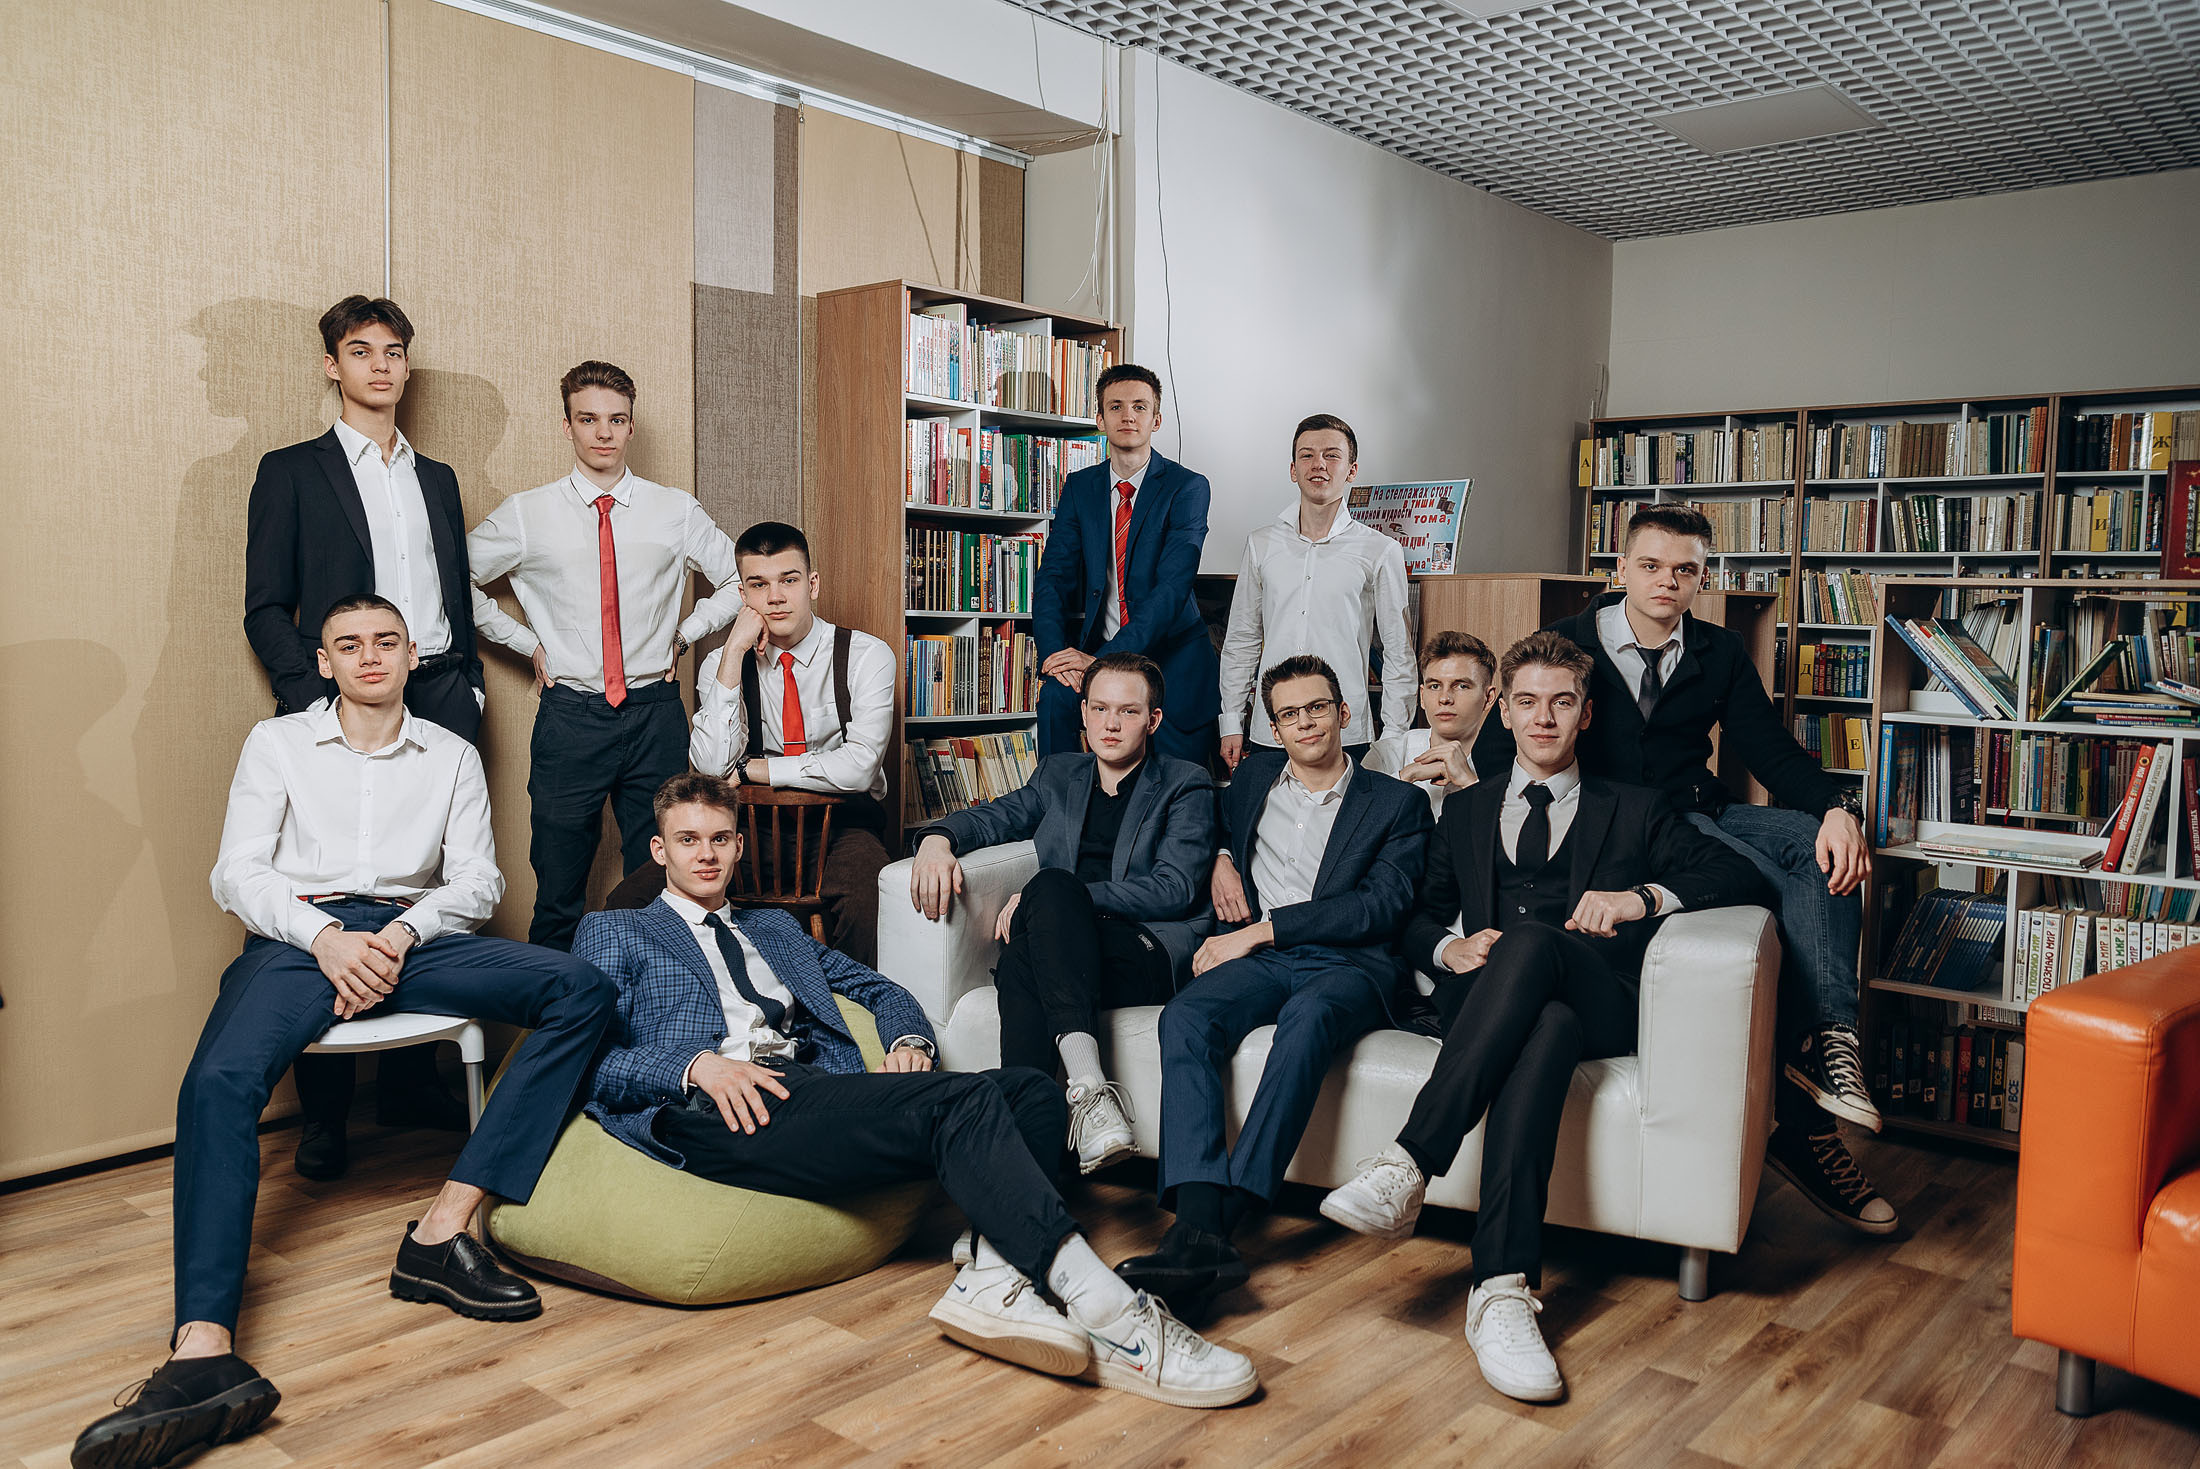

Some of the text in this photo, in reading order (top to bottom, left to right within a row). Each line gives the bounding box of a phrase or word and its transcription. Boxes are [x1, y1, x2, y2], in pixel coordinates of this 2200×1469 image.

[2153, 436, 2172, 448] Ж
[1581, 457, 1590, 468] А
[1373, 486, 1383, 501] На
[1430, 485, 1453, 499] стоят
[1403, 498, 1434, 509] в тиши
[1349, 507, 1412, 523] семирной мудрости
[1414, 514, 1451, 525] тома,
[2095, 518, 2107, 531] И
[1800, 663, 1812, 676] Д
[1850, 738, 1860, 750] Е
[2190, 809, 2200, 851] ЖИВОТНЫХ
[2032, 934, 2041, 952] МИР
[2046, 930, 2055, 950] МИР
[2075, 937, 2084, 957] МИР
[2115, 936, 2125, 957] МИР
[2100, 940, 2109, 958] МИР
[2029, 953, 2039, 987] ПОЗНАЮ
[2042, 951, 2054, 990] ПОЗНАЮ
[2008, 1080, 2019, 1103] ВСЕ
